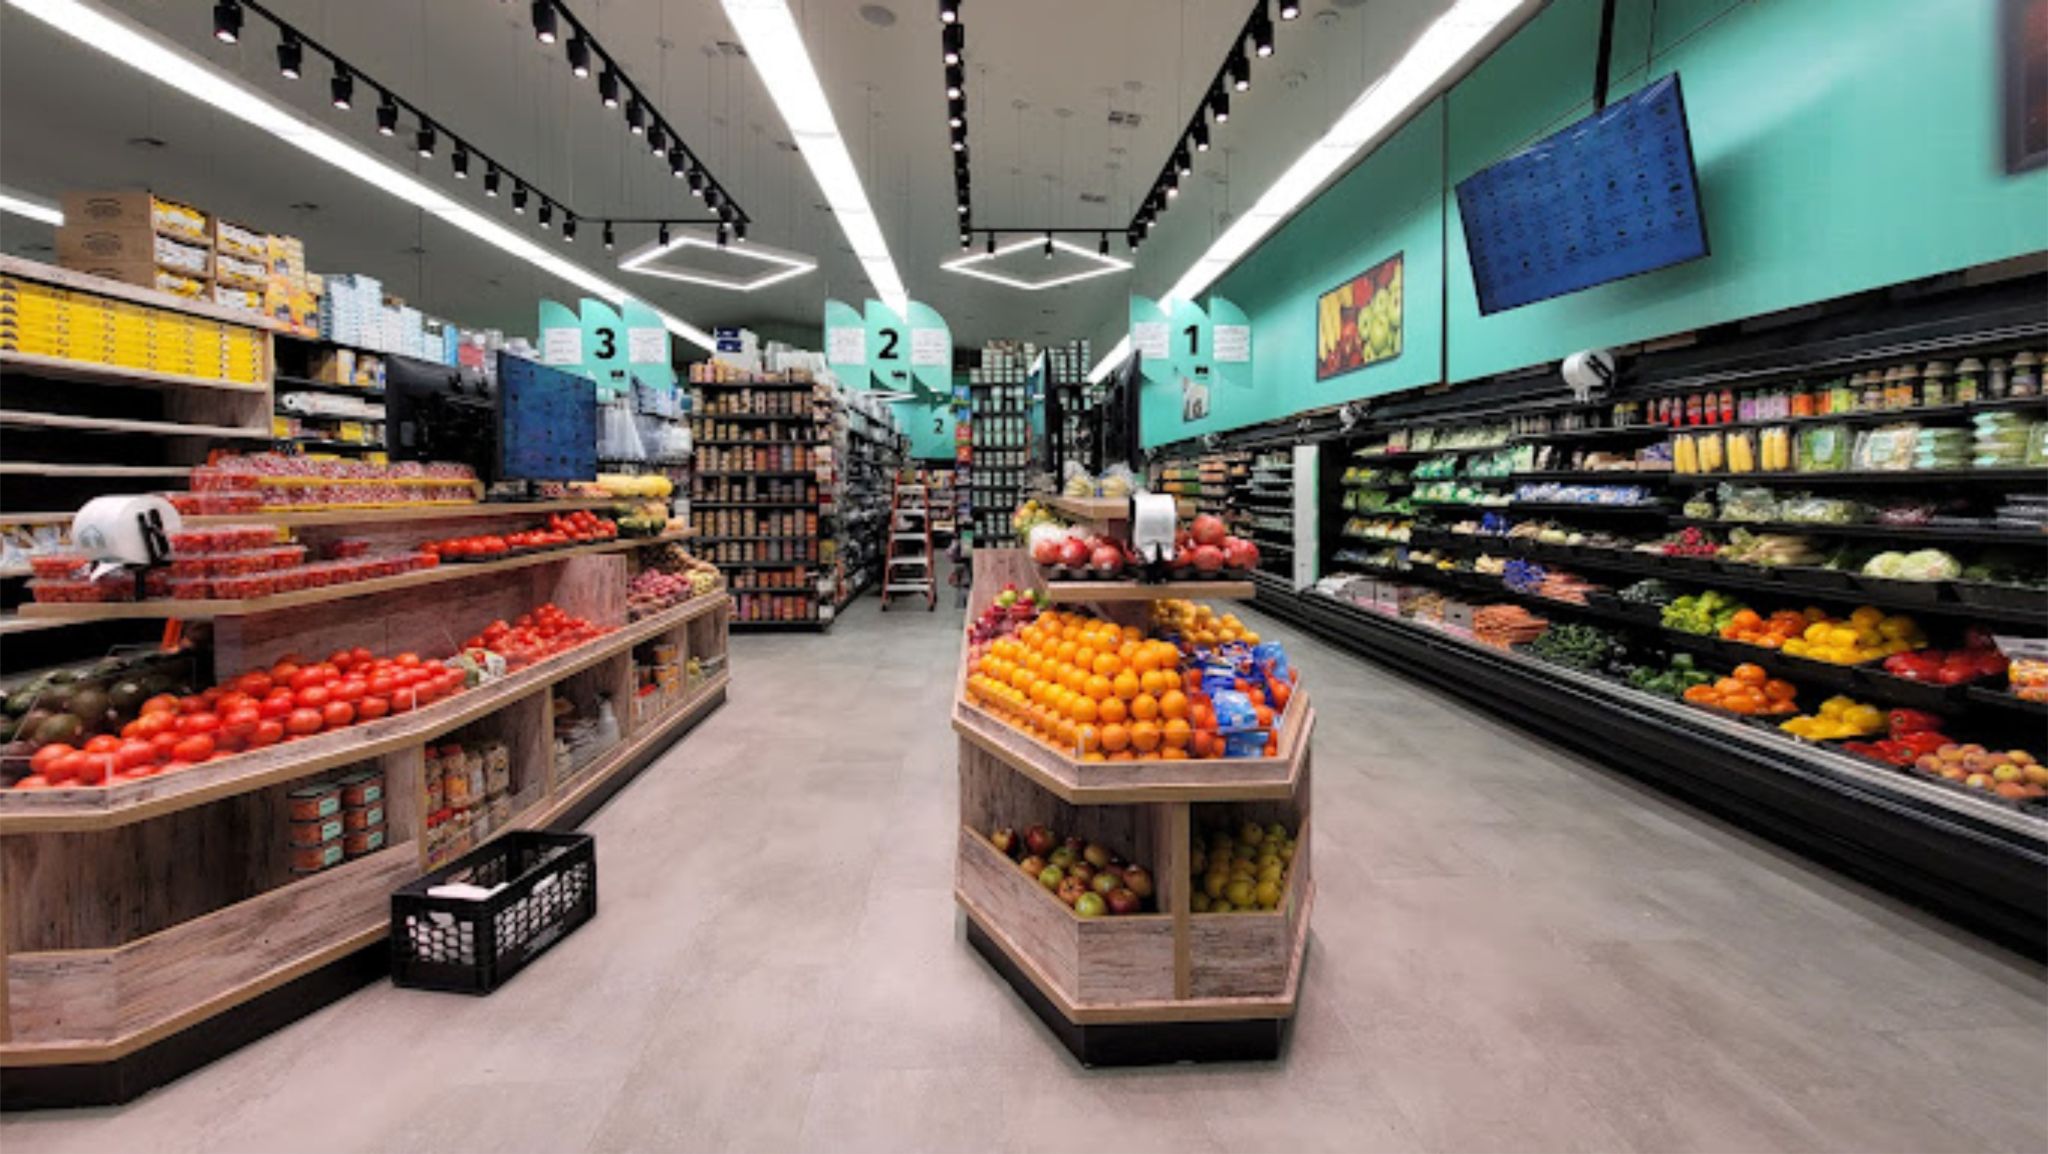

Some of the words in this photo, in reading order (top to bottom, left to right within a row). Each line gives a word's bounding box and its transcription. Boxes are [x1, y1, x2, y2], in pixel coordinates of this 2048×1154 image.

[594, 327, 616, 360] 3
[878, 328, 899, 360] 2
[1183, 324, 1199, 355] 1
[933, 418, 944, 434] 2
